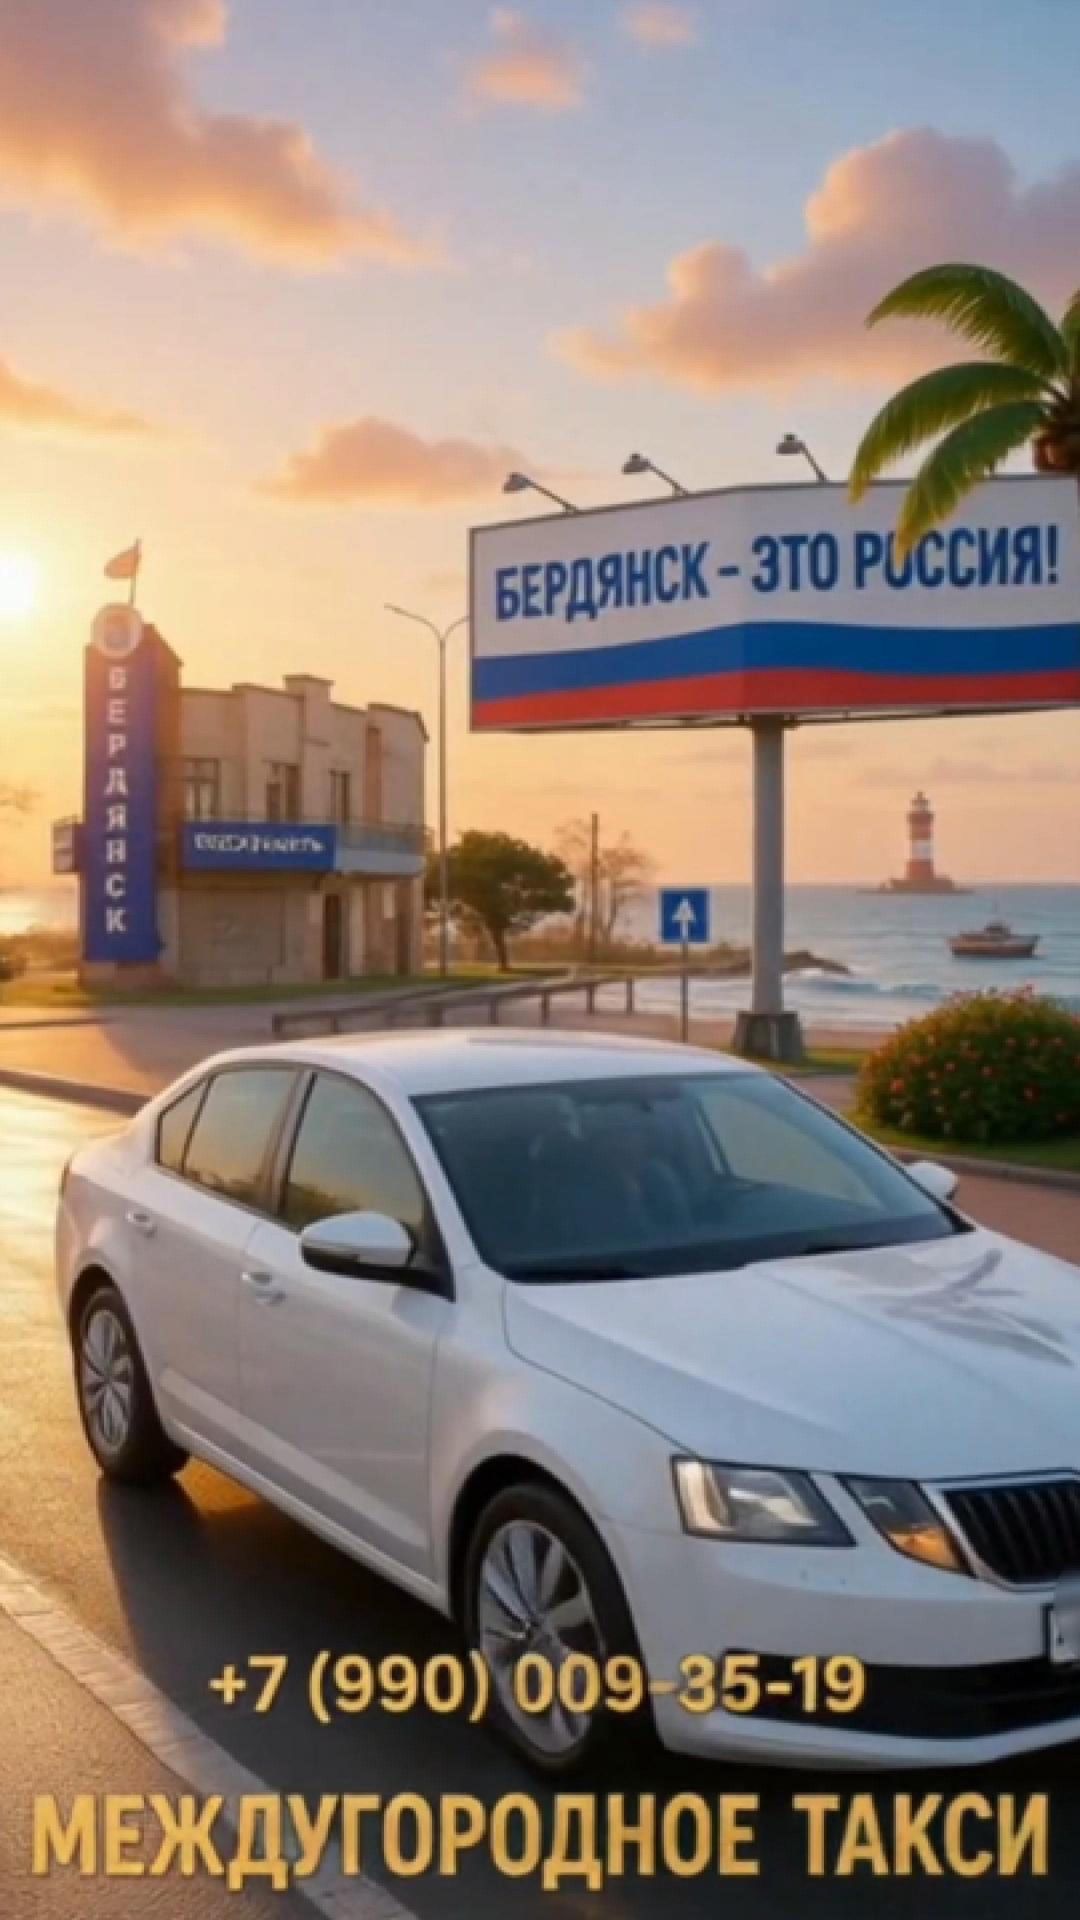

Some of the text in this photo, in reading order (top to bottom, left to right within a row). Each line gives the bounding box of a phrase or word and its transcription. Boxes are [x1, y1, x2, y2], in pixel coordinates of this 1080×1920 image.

[495, 541, 710, 622] БЕРДЯНСК
[751, 533, 839, 593] ЭТО
[854, 525, 1059, 590] РОССИЯ!
